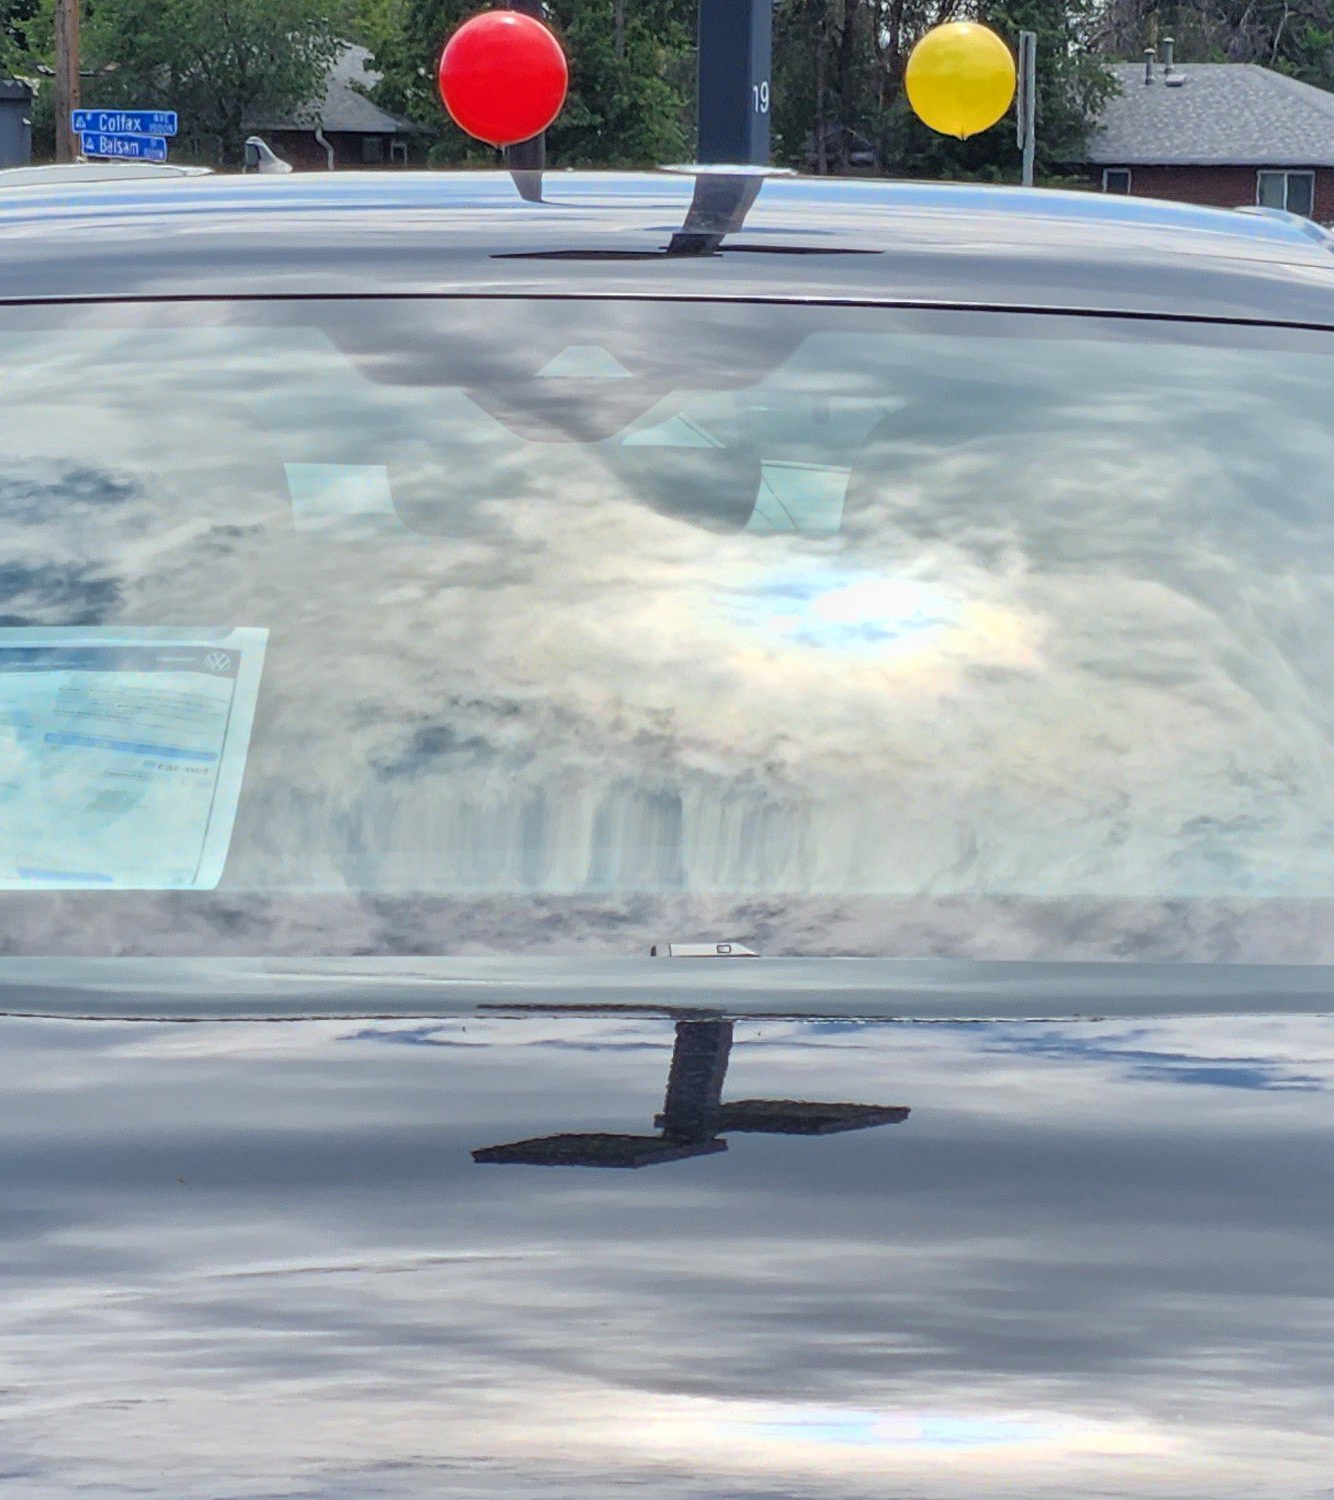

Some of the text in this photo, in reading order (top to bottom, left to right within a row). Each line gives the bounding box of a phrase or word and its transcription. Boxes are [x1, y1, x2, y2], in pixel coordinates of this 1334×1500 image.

[753, 80, 770, 113] 19
[98, 113, 142, 131] Colfax
[99, 136, 139, 156] Balsam
